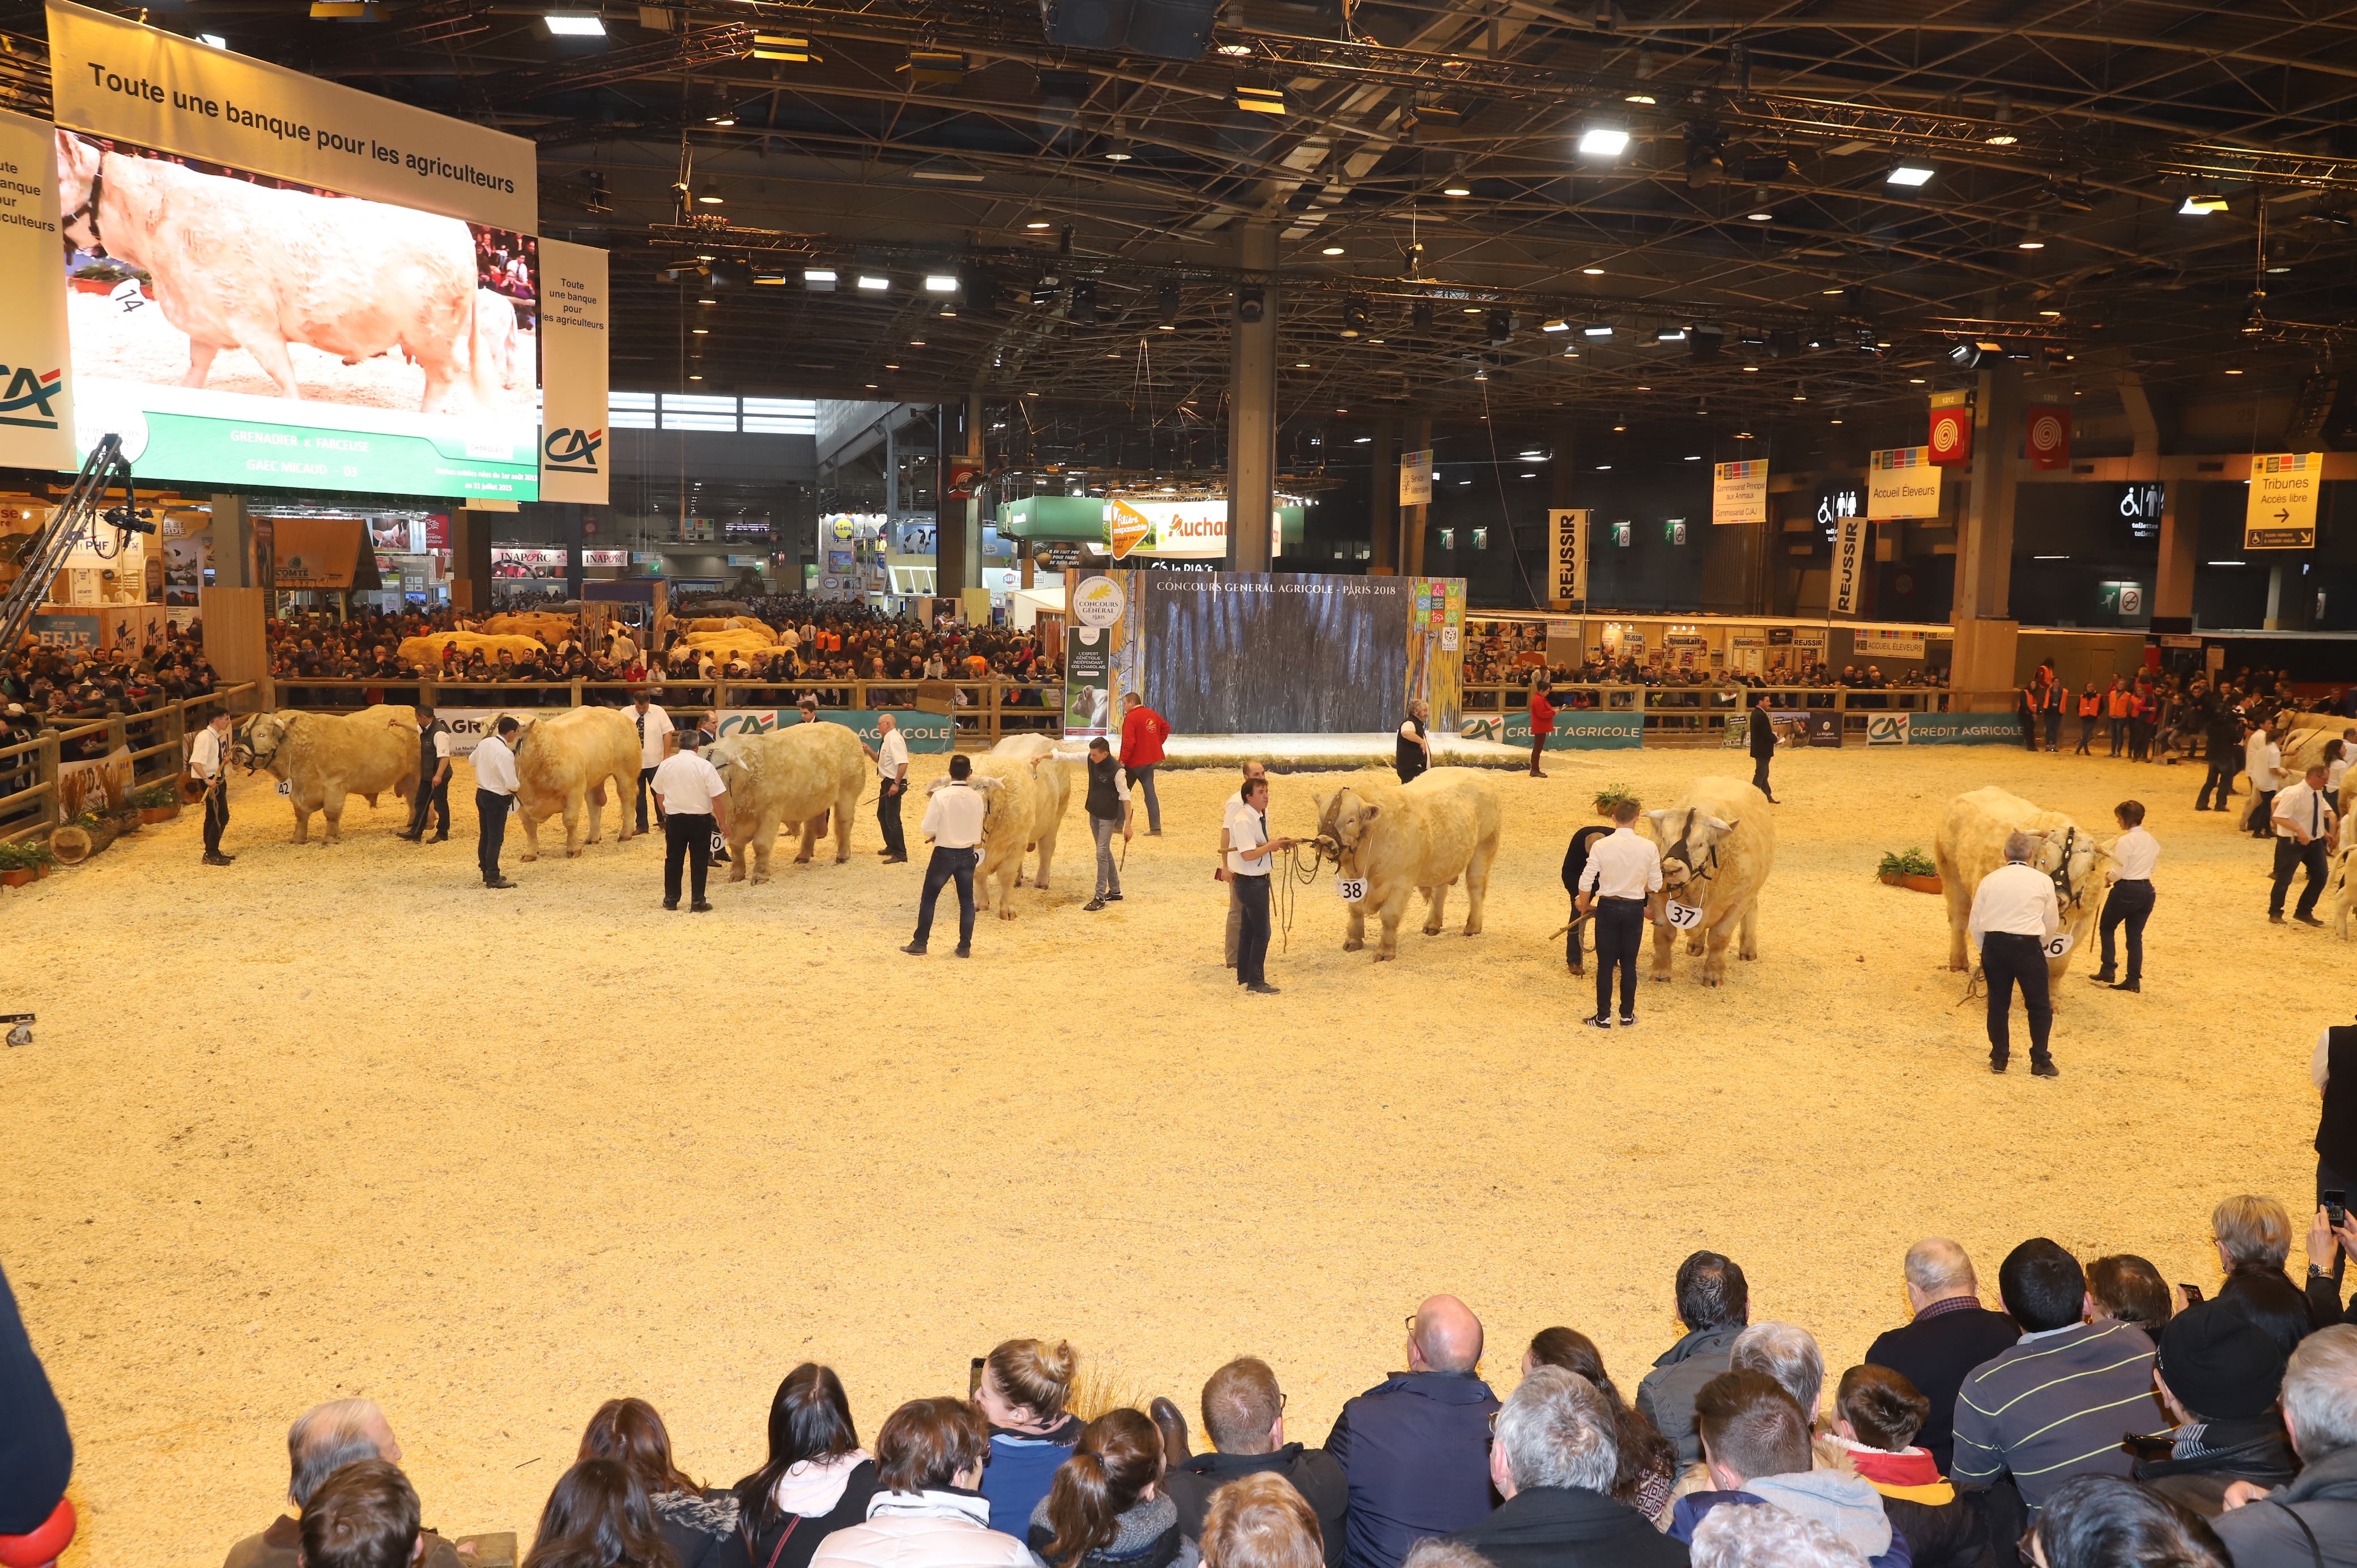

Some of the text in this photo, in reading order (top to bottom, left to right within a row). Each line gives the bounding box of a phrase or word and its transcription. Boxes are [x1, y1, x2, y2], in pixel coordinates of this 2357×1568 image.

[88, 62, 514, 193] Toute une banque pour les agriculteurs
[561, 278, 584, 289] Toute
[115, 289, 144, 313] 14
[550, 291, 597, 304] une banque
[563, 305, 582, 314] pour
[542, 312, 604, 330] les agriculteurs
[231, 429, 370, 452] GRENADIER x FARCEUSE
[470, 445, 504, 453] CHAROLAIS
[246, 459, 278, 472] GAEC
[281, 461, 327, 475] MICAUD
[344, 466, 358, 477] 03
[1747, 482, 1765, 491] Principal
[2263, 478, 2309, 490] Tribunes
[1873, 484, 1935, 498] Accueil Éleveurs
[2261, 493, 2307, 504] Accès libre
[1117, 513, 1139, 527] filière
[1113, 523, 1147, 535] responsable
[86, 541, 109, 551] PHF
[501, 551, 551, 563] INAPORC
[585, 552, 623, 564] INAPORC
[1077, 578, 1091, 594] CONCOURS
[1108, 580, 1121, 594] AGRICOLE
[1157, 582, 1222, 593] CONCOURS
[1224, 583, 1275, 593] GENERAL
[1278, 584, 1333, 594] AGRICOLE
[1343, 580, 1371, 596] PARIS
[1374, 585, 1396, 595] 2018
[1669, 637, 1700, 646] RéussirLait
[1892, 642, 1922, 652] ÉLEVEURS
[858, 728, 950, 739] AGICOLE
[1564, 726, 1640, 738] AGRICOLE
[1911, 725, 2024, 736] CRÉDIT AGRICOLE
[279, 783, 290, 795] 42
[710, 836, 721, 849] 0
[1342, 883, 1363, 898] 38
[1670, 906, 1696, 926] 37
